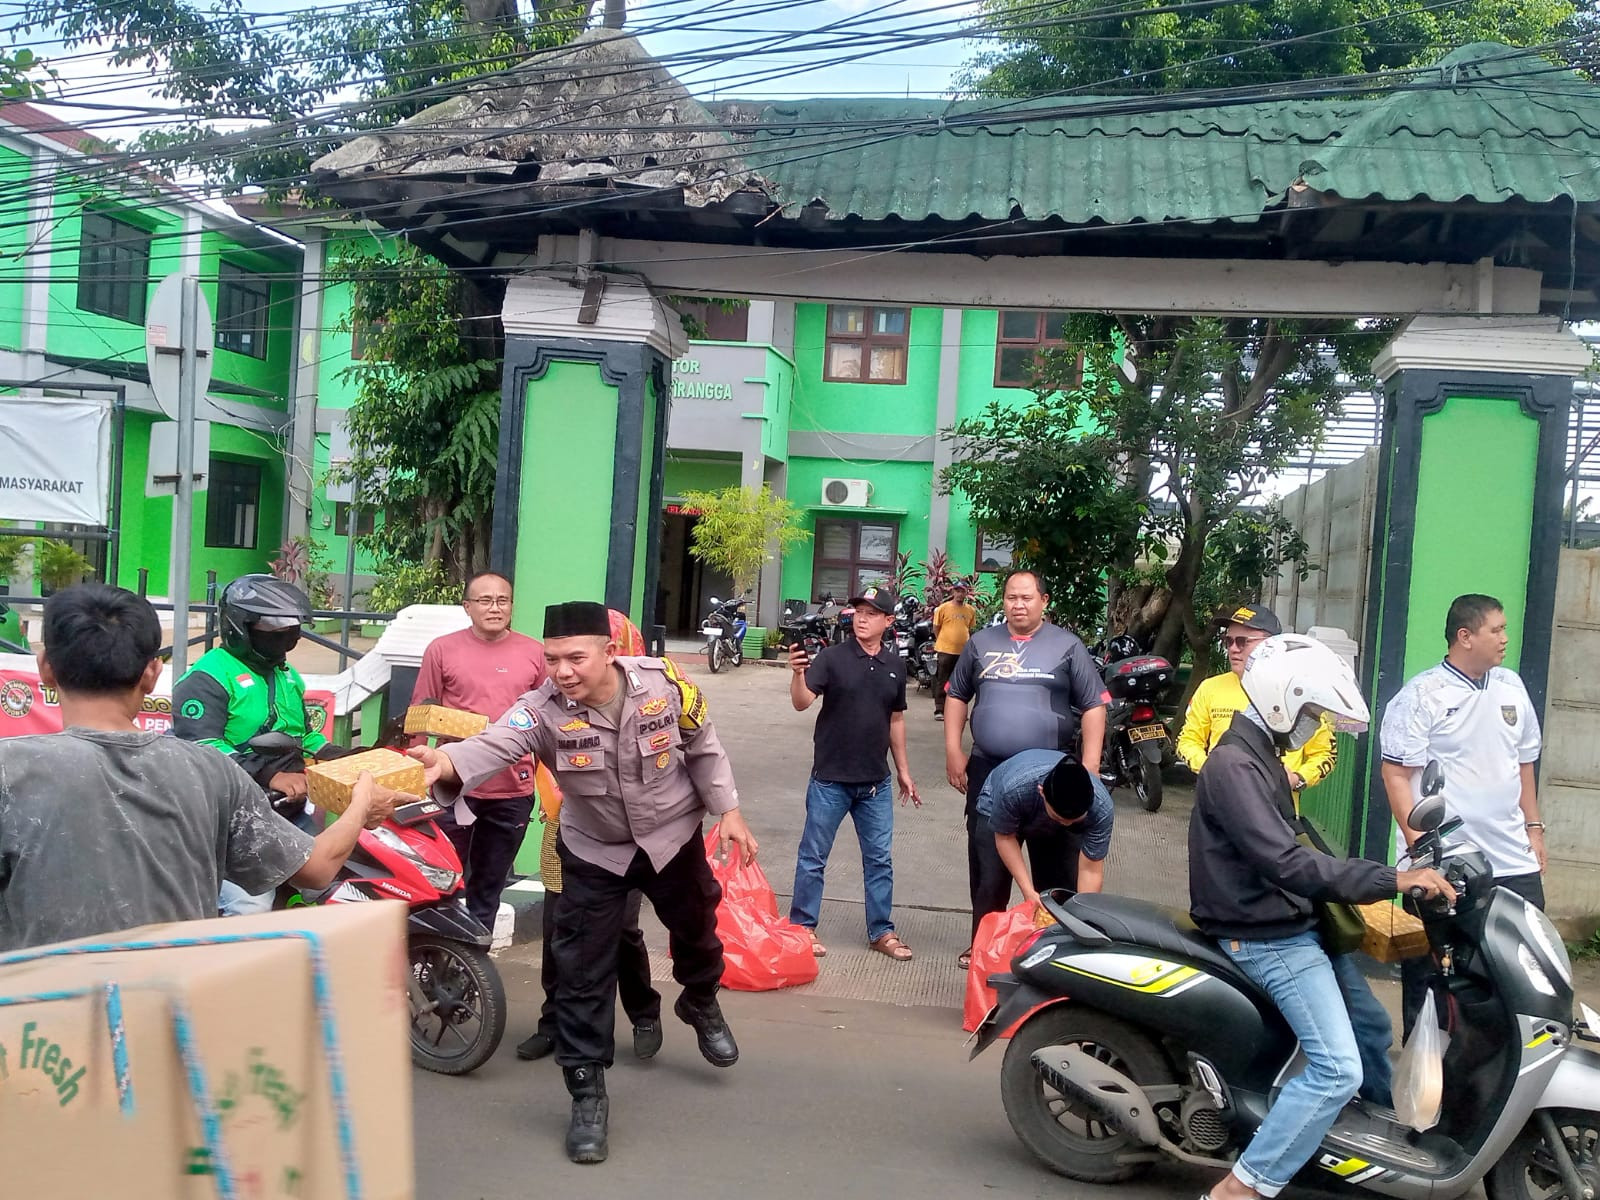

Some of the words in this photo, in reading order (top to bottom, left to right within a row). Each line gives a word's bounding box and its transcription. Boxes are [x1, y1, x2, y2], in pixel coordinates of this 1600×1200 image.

[672, 381, 733, 401] IRANGGA
[0, 477, 84, 494] MASYARAKAT
[640, 713, 675, 734] POLRI
[382, 881, 412, 899] HONDA
[20, 1021, 87, 1108] Fresh
